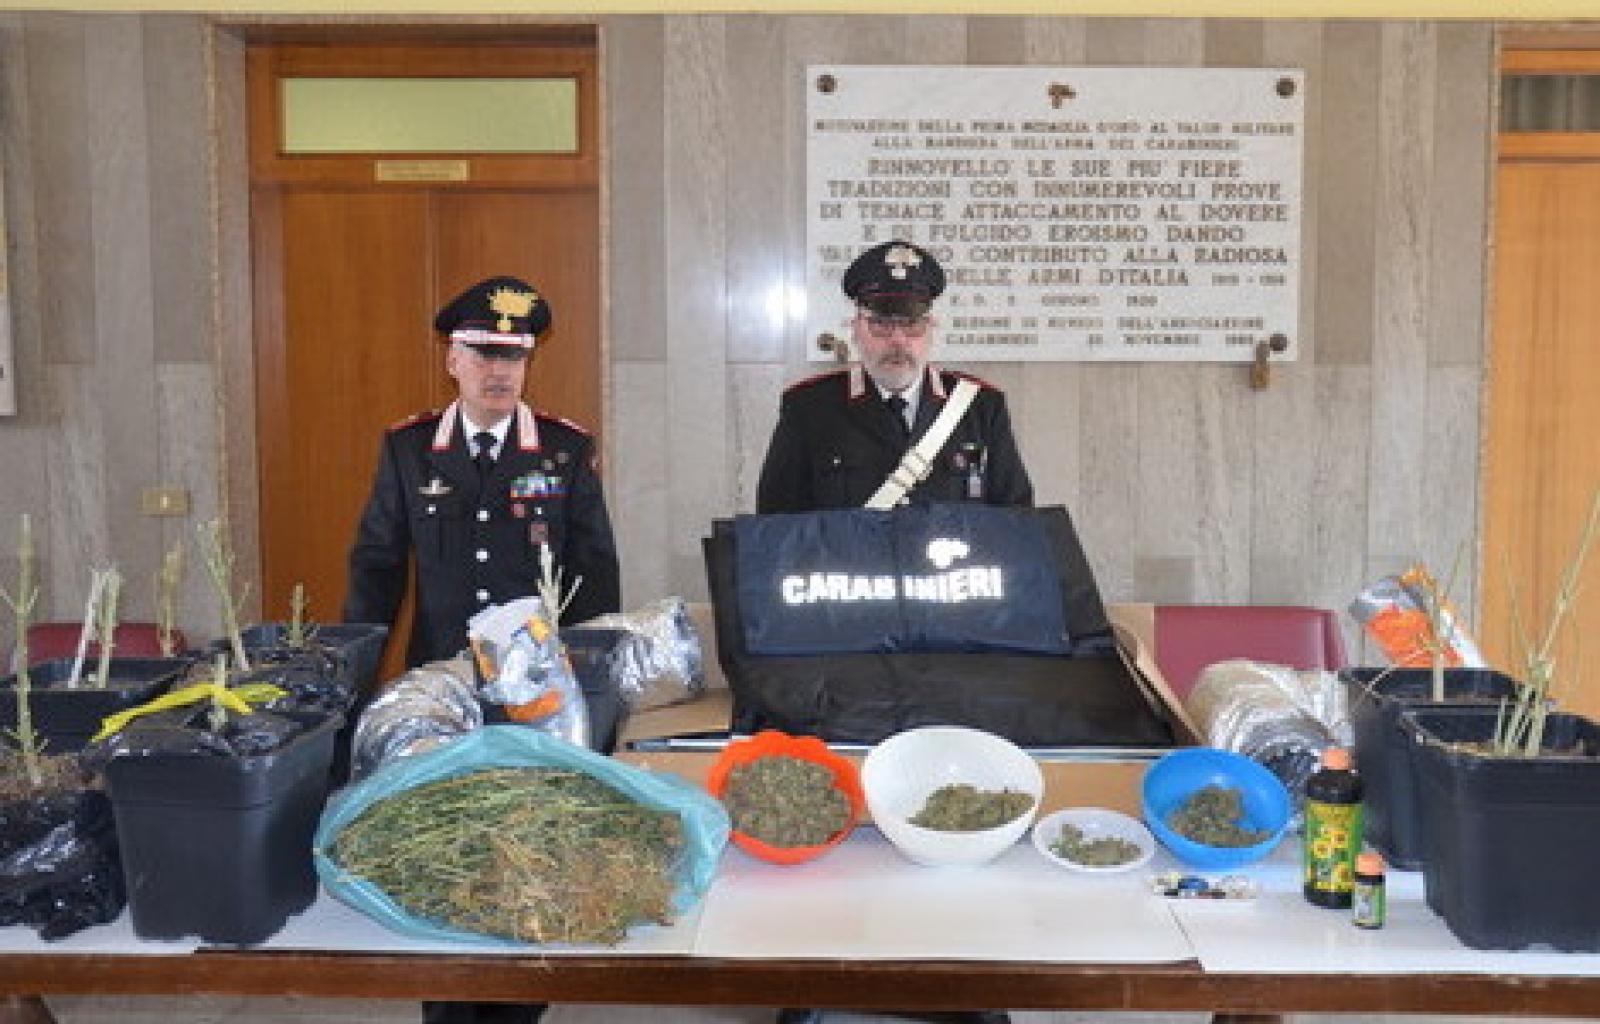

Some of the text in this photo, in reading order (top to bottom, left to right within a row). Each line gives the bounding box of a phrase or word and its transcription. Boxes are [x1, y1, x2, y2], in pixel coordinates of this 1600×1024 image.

[1028, 160, 1055, 177] LE
[1071, 160, 1110, 177] SUE
[1178, 160, 1242, 177] FIERE
[827, 180, 1280, 200] TRADIZIONI CON INNUMEREVOLI PROVE
[820, 203, 1288, 221] DI TENACE ATTACCAMENTO AL DOVERE
[862, 225, 876, 242] E
[1049, 225, 1148, 242] EROISMO
[1167, 225, 1244, 242] DANDO
[970, 246, 1108, 263] CONTRIBUTO
[1124, 248, 1178, 263] ALLA
[1195, 248, 1288, 263] RADIOSA
[1028, 268, 1080, 285] ARMI
